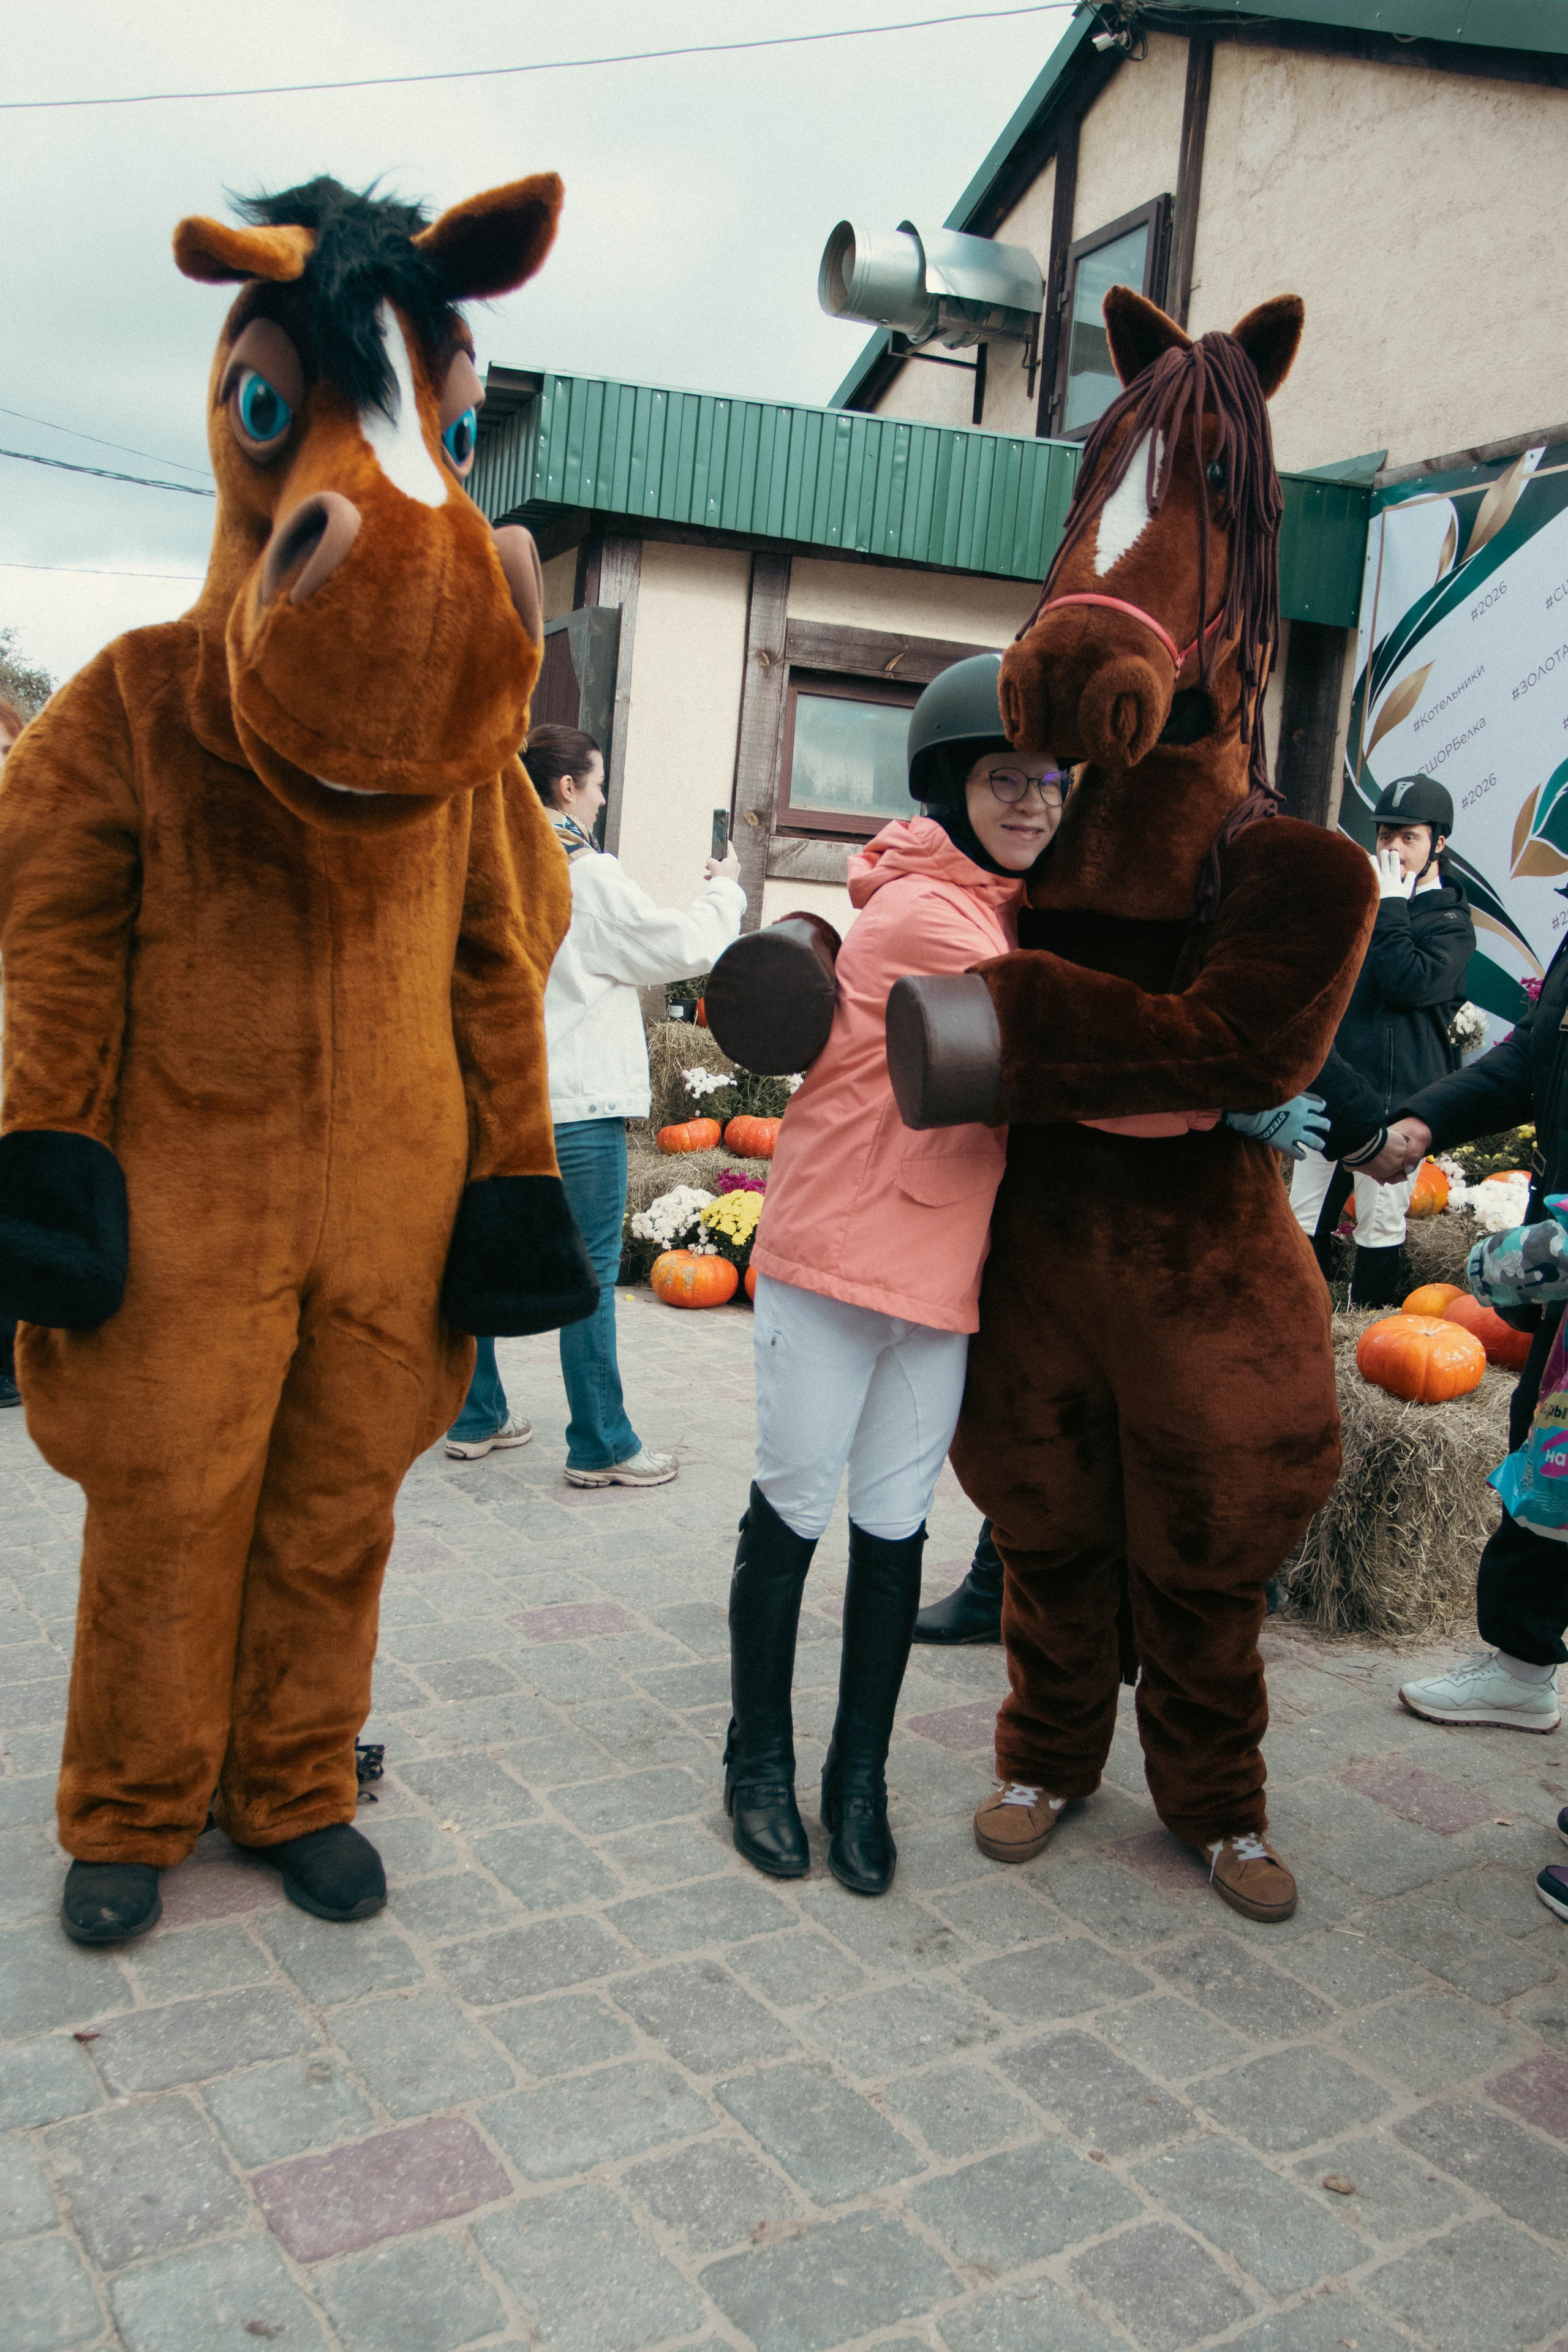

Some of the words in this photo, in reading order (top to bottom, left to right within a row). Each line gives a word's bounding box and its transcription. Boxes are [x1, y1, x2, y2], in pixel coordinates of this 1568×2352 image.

[1471, 581, 1507, 621] #2026
[1413, 665, 1485, 733] #Котельники
[1461, 773, 1496, 809] #2026
[1552, 910, 1568, 930] #2
